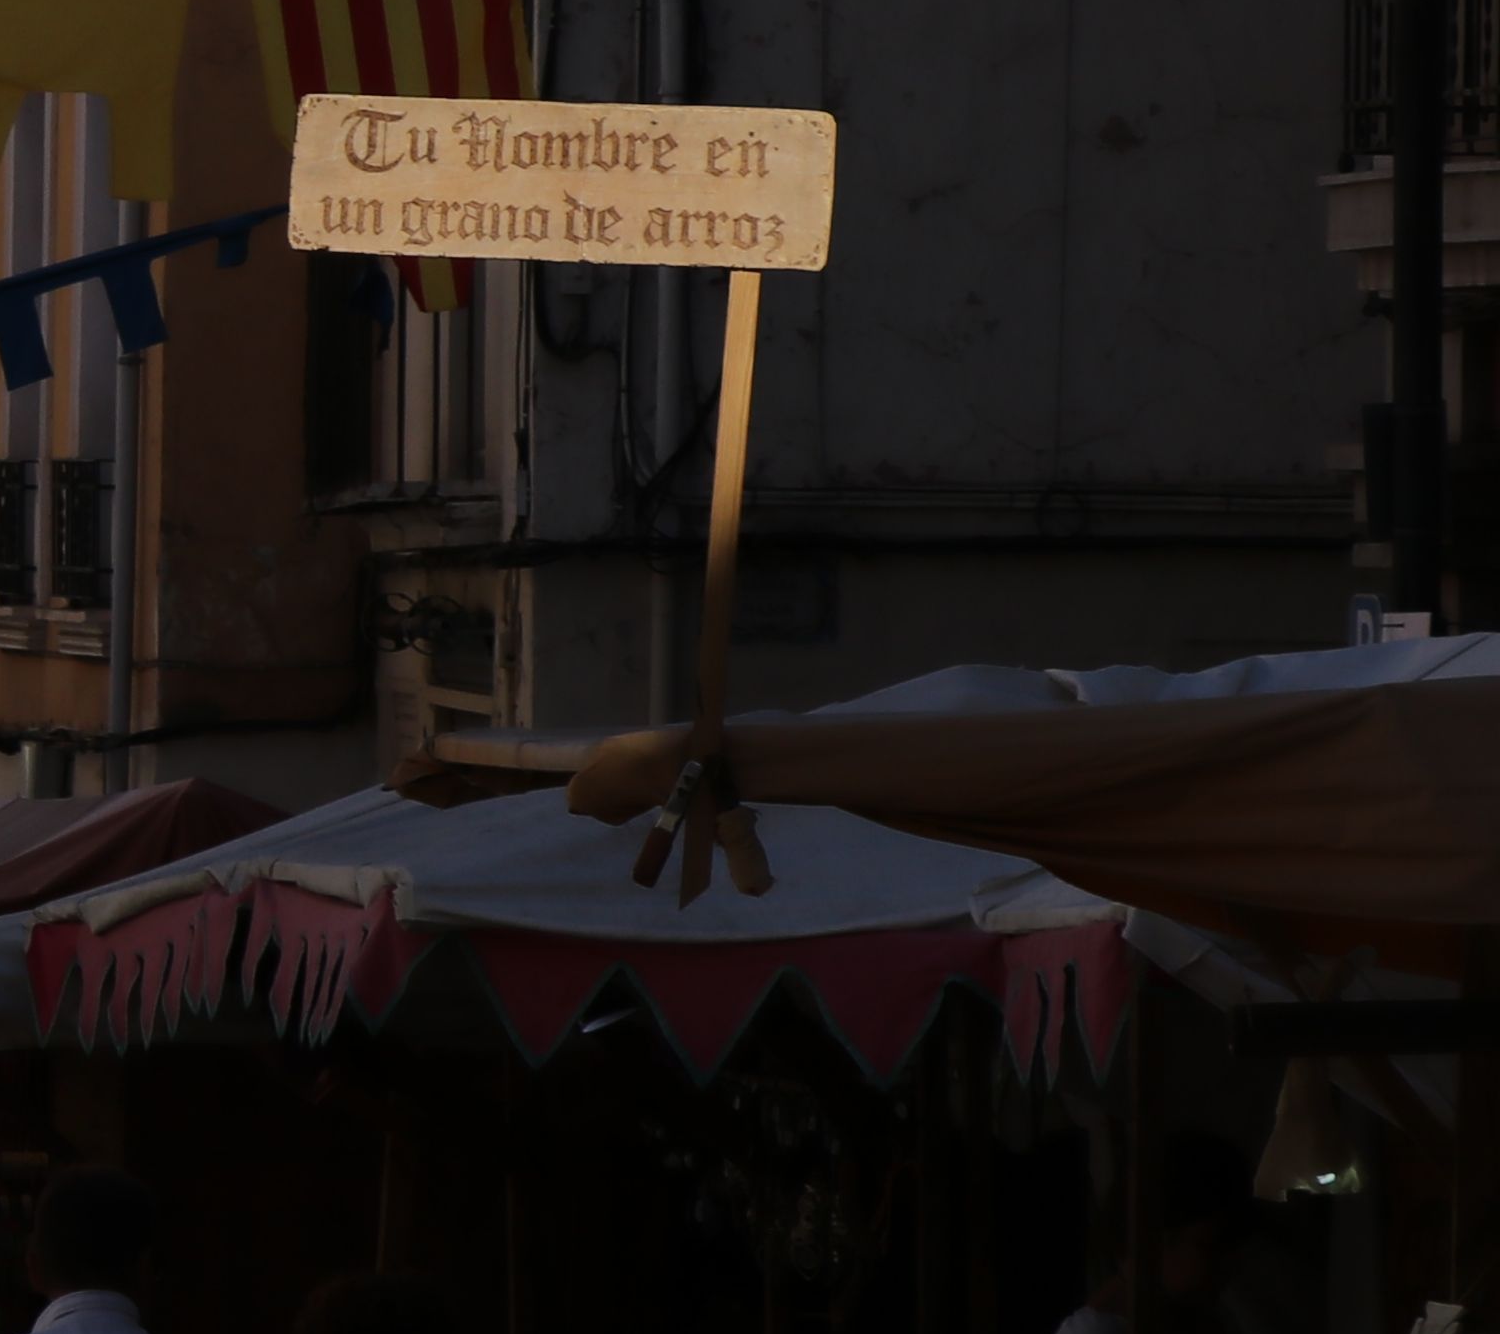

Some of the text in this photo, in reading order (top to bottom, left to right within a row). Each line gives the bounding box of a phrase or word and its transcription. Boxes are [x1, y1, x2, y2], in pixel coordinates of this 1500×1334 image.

[342, 108, 770, 178] Tu Nombre en
[320, 190, 786, 261] un grano de arroz
